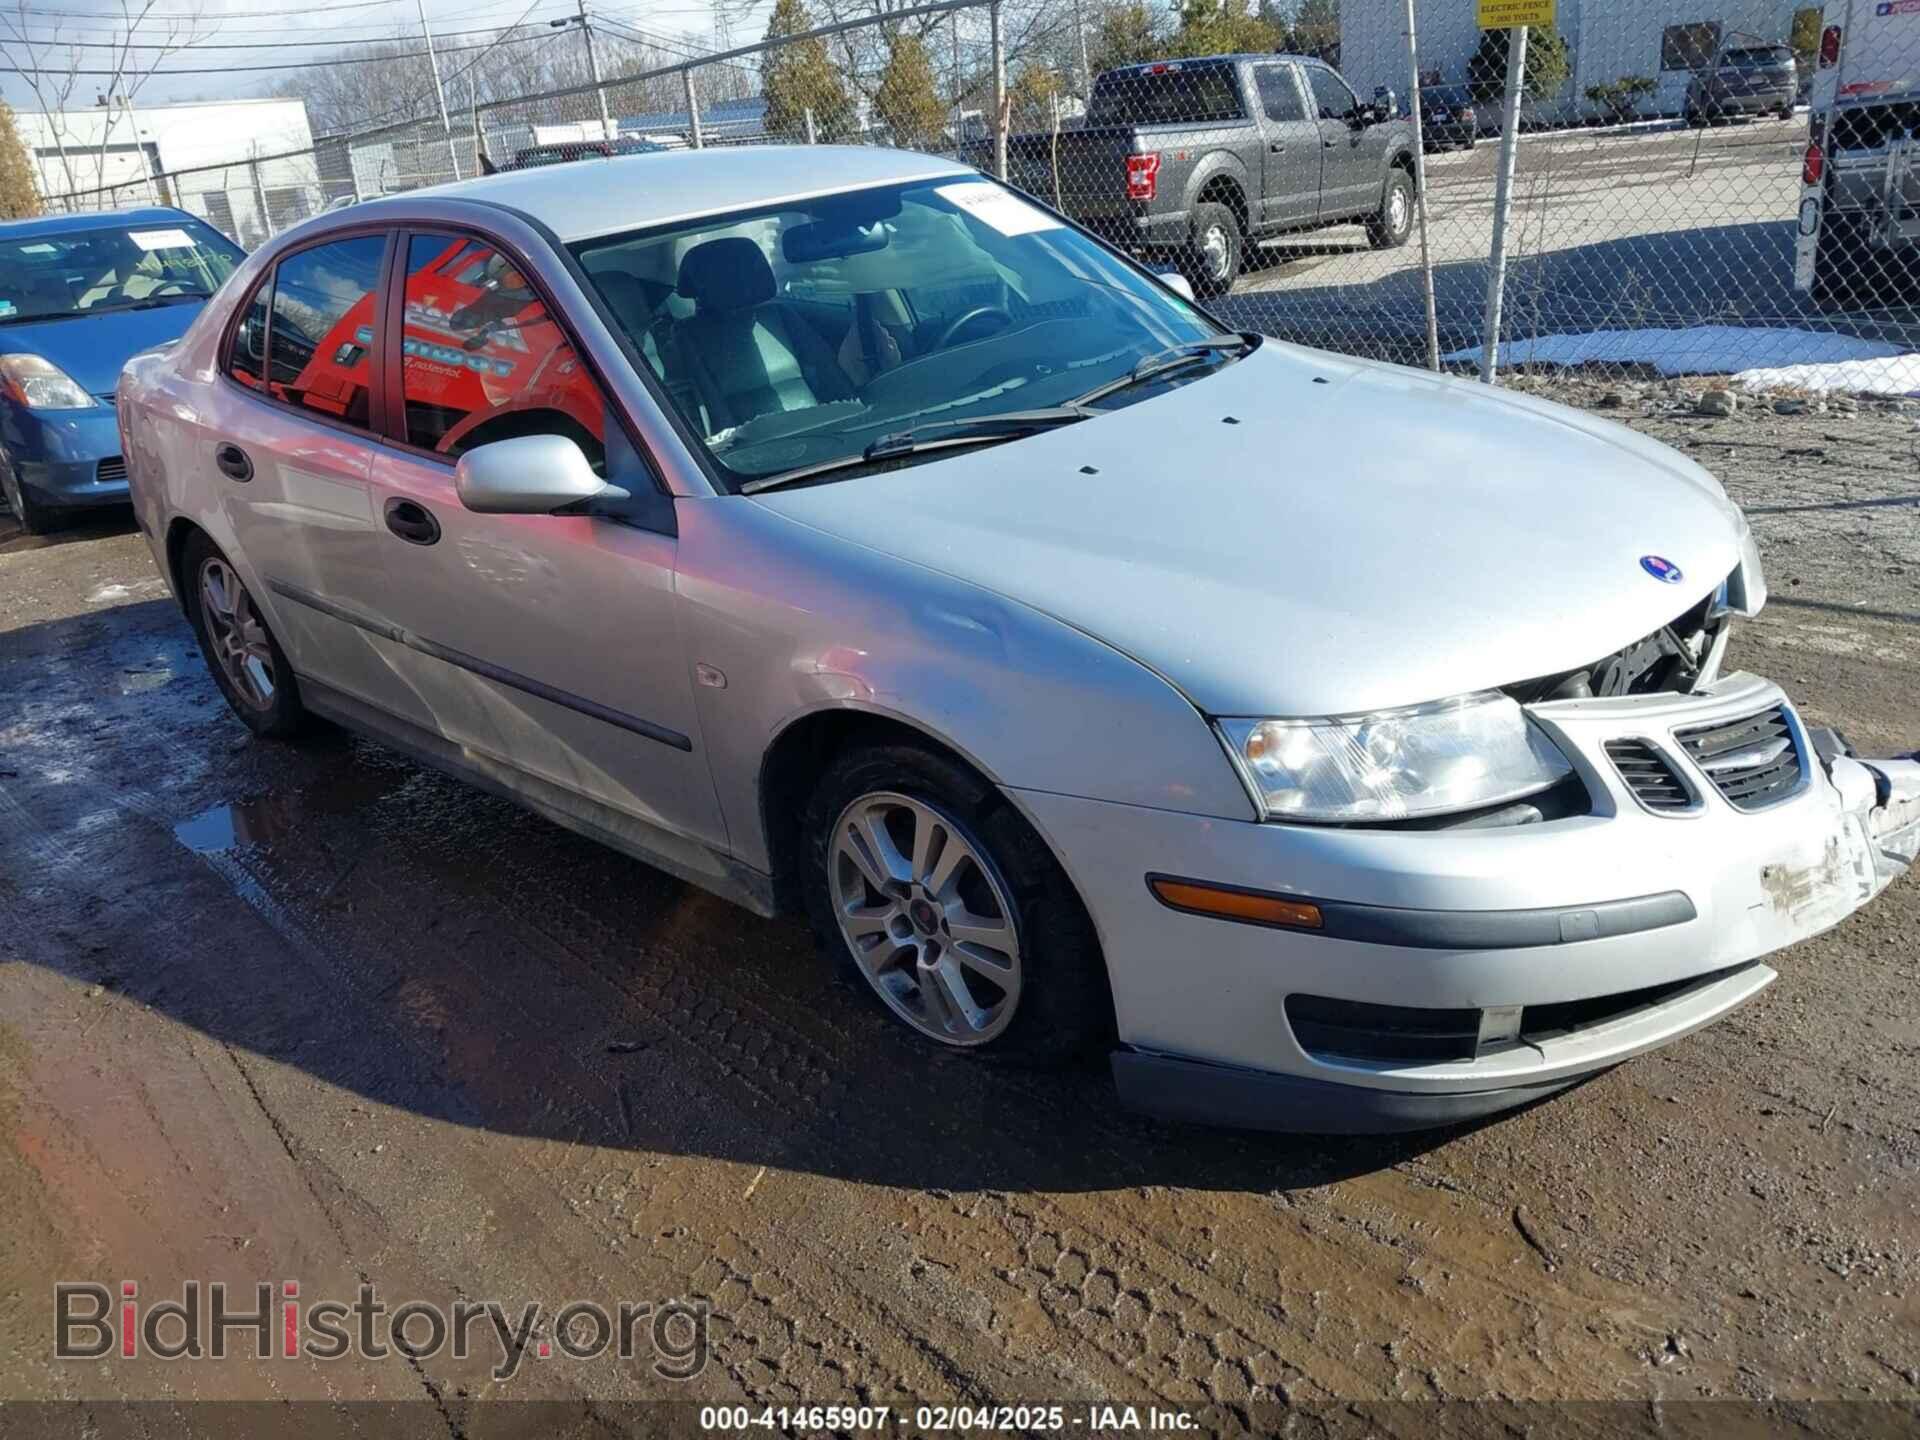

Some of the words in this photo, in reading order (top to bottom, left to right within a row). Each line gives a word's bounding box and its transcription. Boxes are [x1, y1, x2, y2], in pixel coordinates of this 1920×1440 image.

[1481, 3, 1520, 13] ELECTRIC
[1523, 0, 1550, 9] FENCE
[1513, 12, 1540, 21] VOLTS
